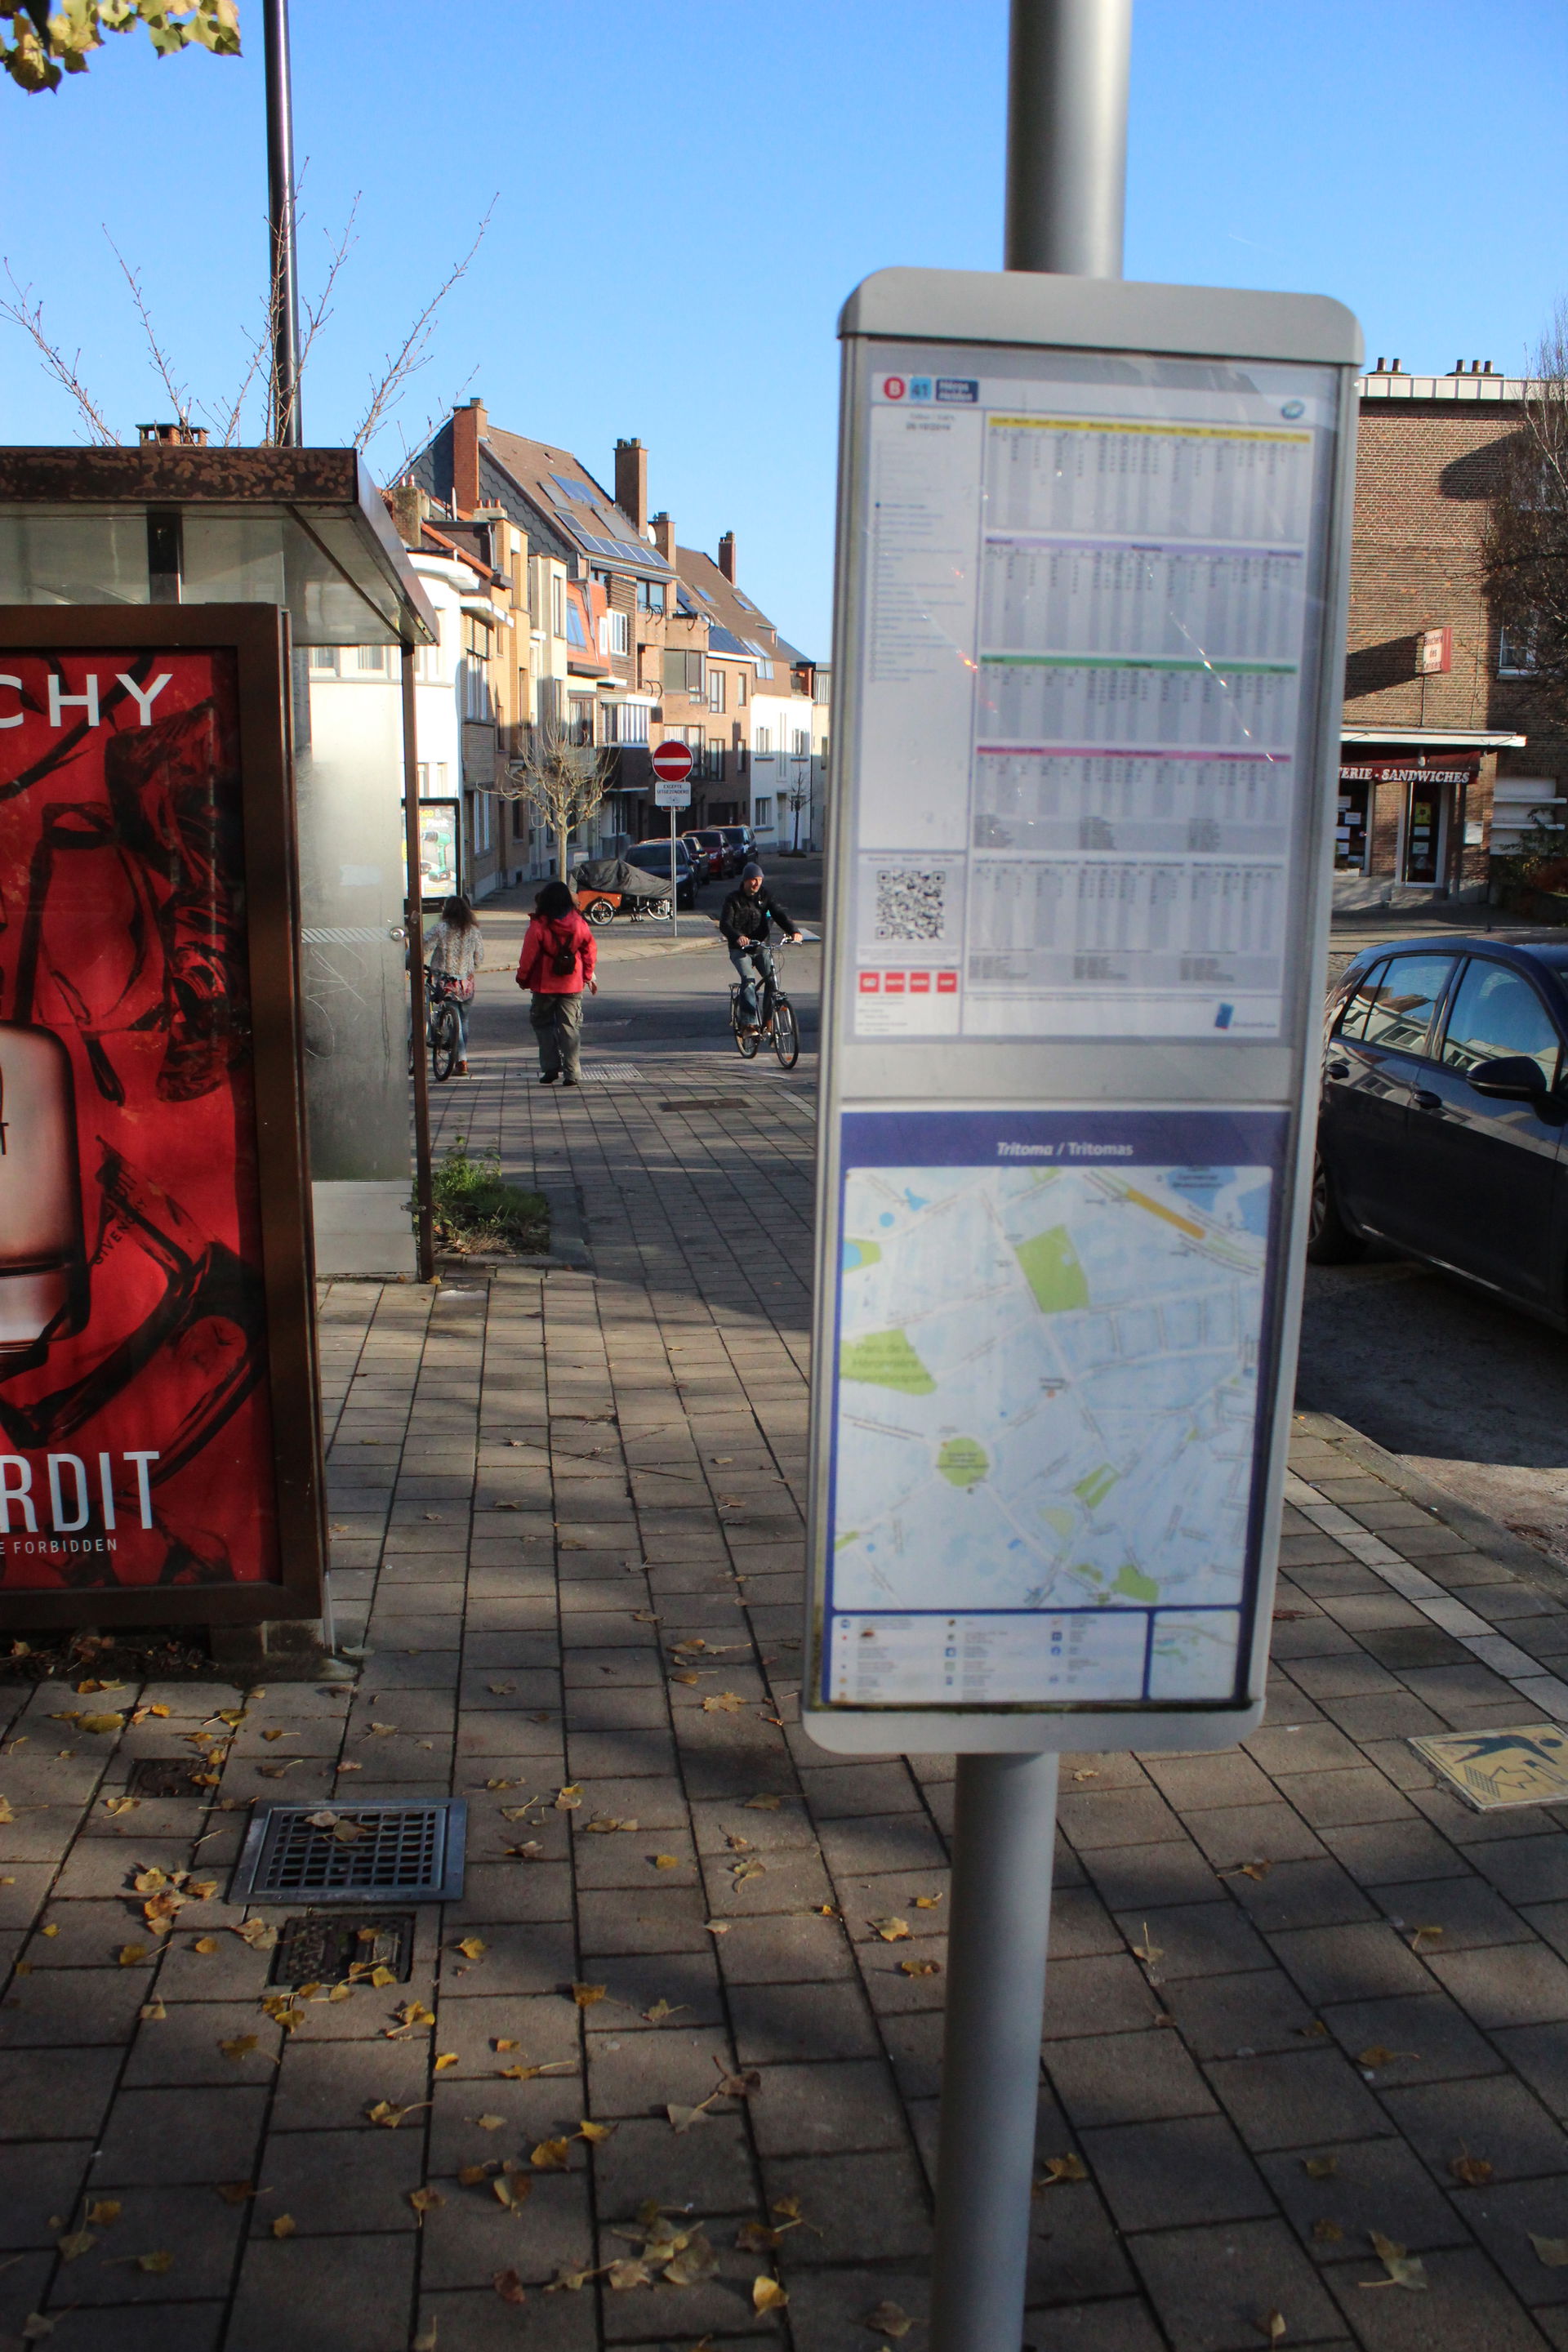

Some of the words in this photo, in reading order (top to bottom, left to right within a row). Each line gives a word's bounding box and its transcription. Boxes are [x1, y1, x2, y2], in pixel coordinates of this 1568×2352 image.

[911, 384, 929, 398] 41
[1381, 768, 1470, 783] SANDWICHES
[997, 1142, 1054, 1156] Tritoma
[1067, 1142, 1134, 1156] Tritomas
[0, 1450, 160, 1534] RDIT
[14, 1539, 117, 1554] FORBIDDEN
